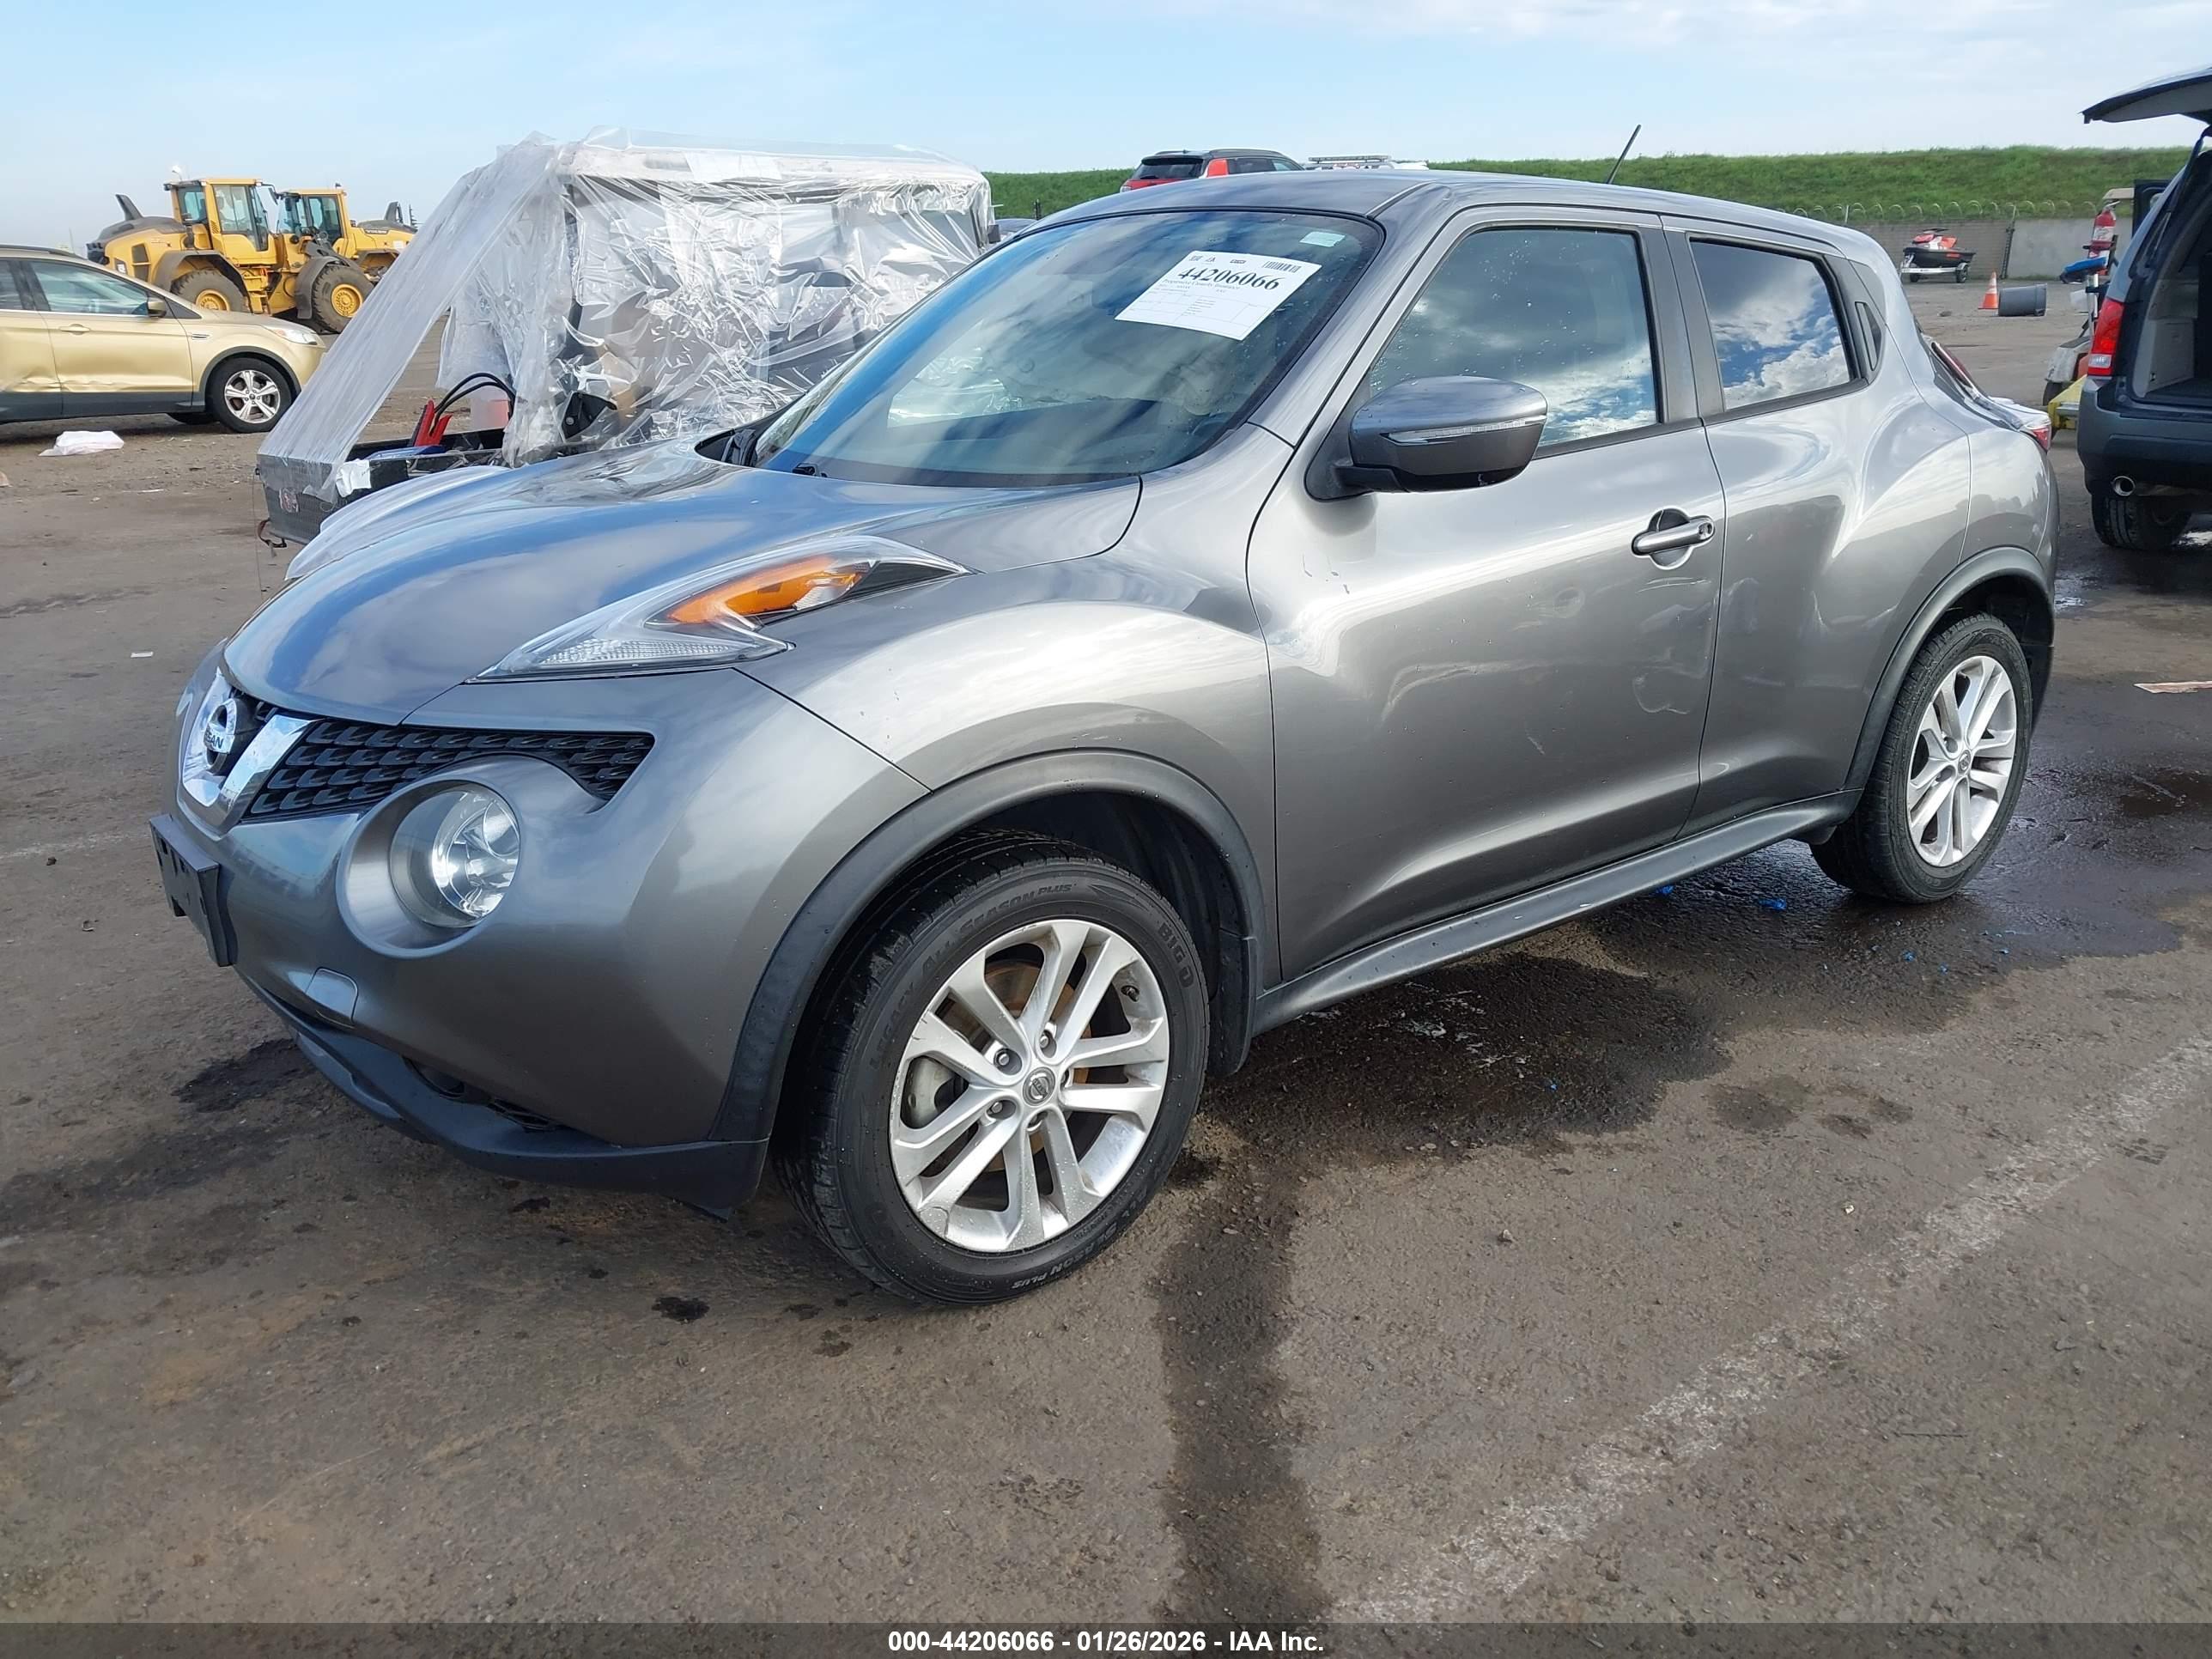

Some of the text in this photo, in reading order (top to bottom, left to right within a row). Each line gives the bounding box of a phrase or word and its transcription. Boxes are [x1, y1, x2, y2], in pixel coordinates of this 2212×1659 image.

[1178, 267, 1286, 290] 44206066
[1035, 883, 1073, 895] PLUS
[1157, 921, 1186, 963] BIG
[1011, 1272, 1048, 1289] PLUS
